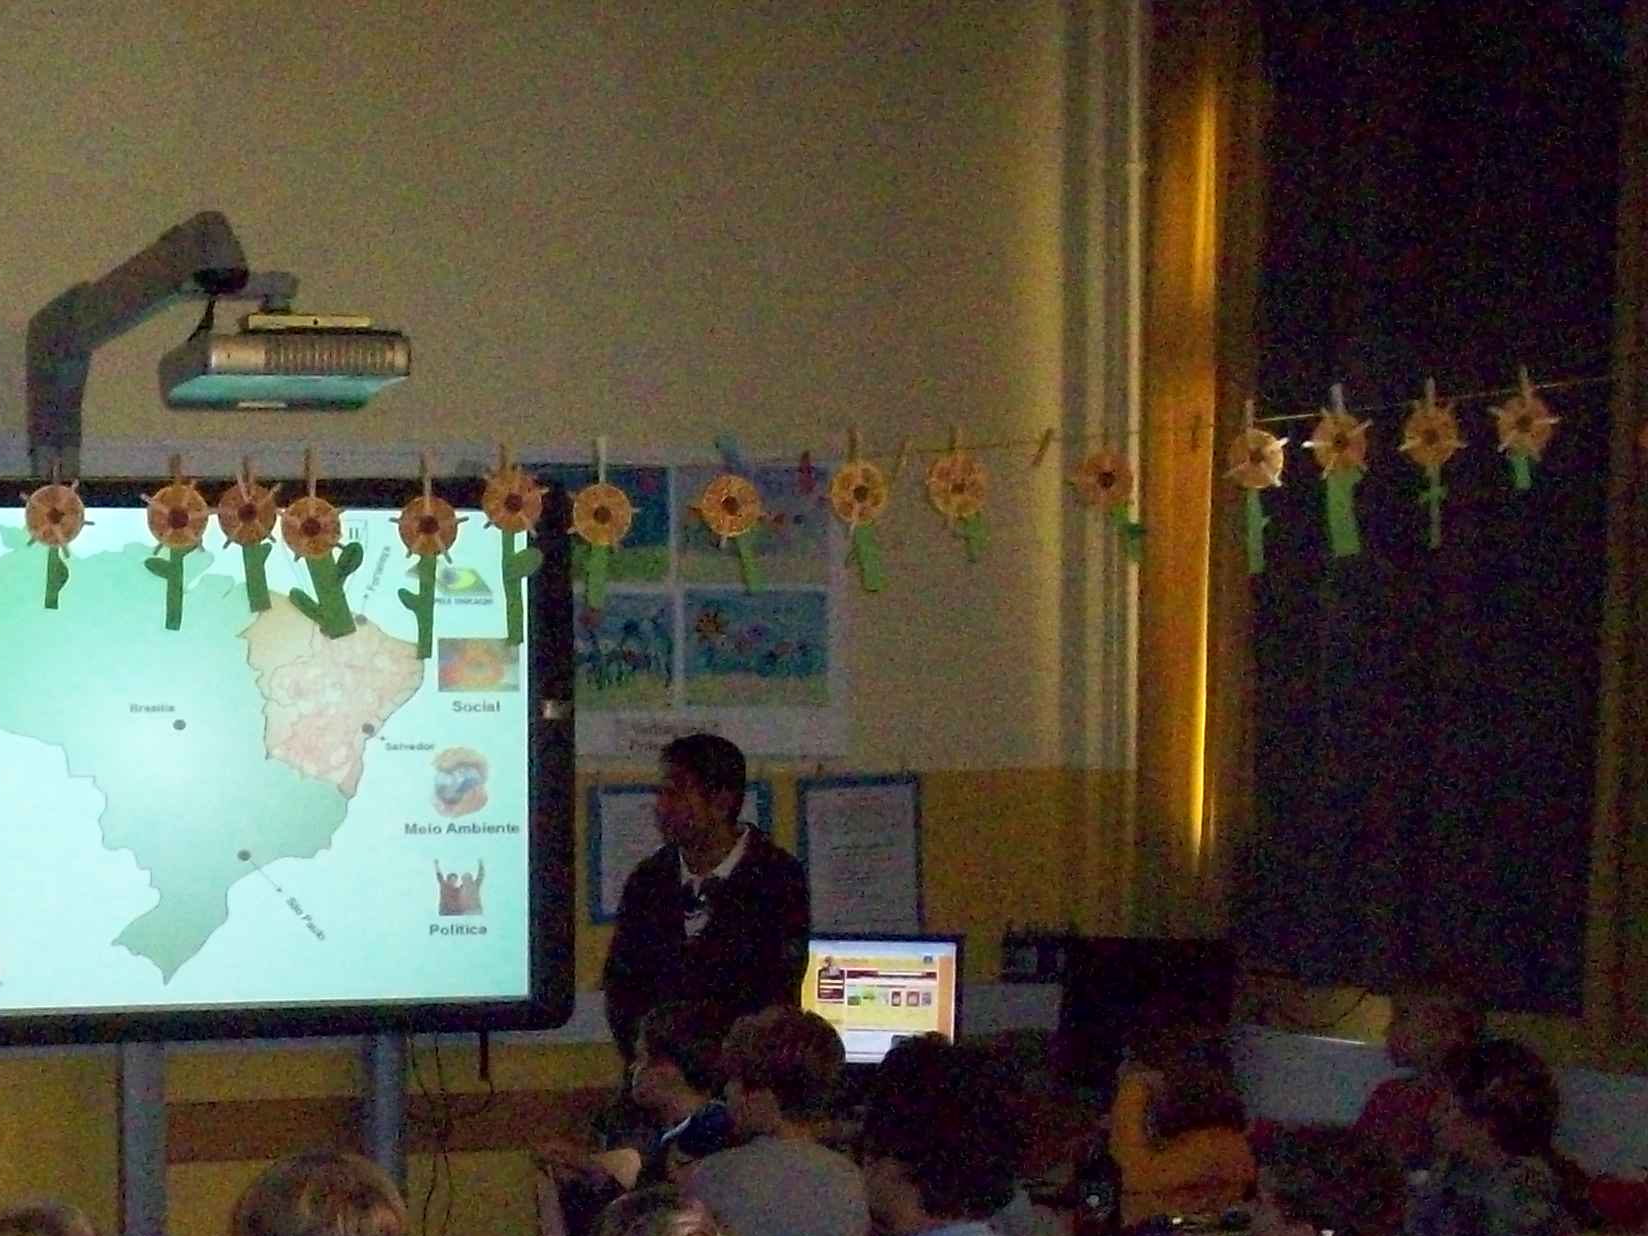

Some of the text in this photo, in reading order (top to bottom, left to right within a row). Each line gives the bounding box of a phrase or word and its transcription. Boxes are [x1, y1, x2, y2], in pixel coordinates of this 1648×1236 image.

[452, 699, 501, 713] Social
[404, 822, 520, 835] Meio Ambiente
